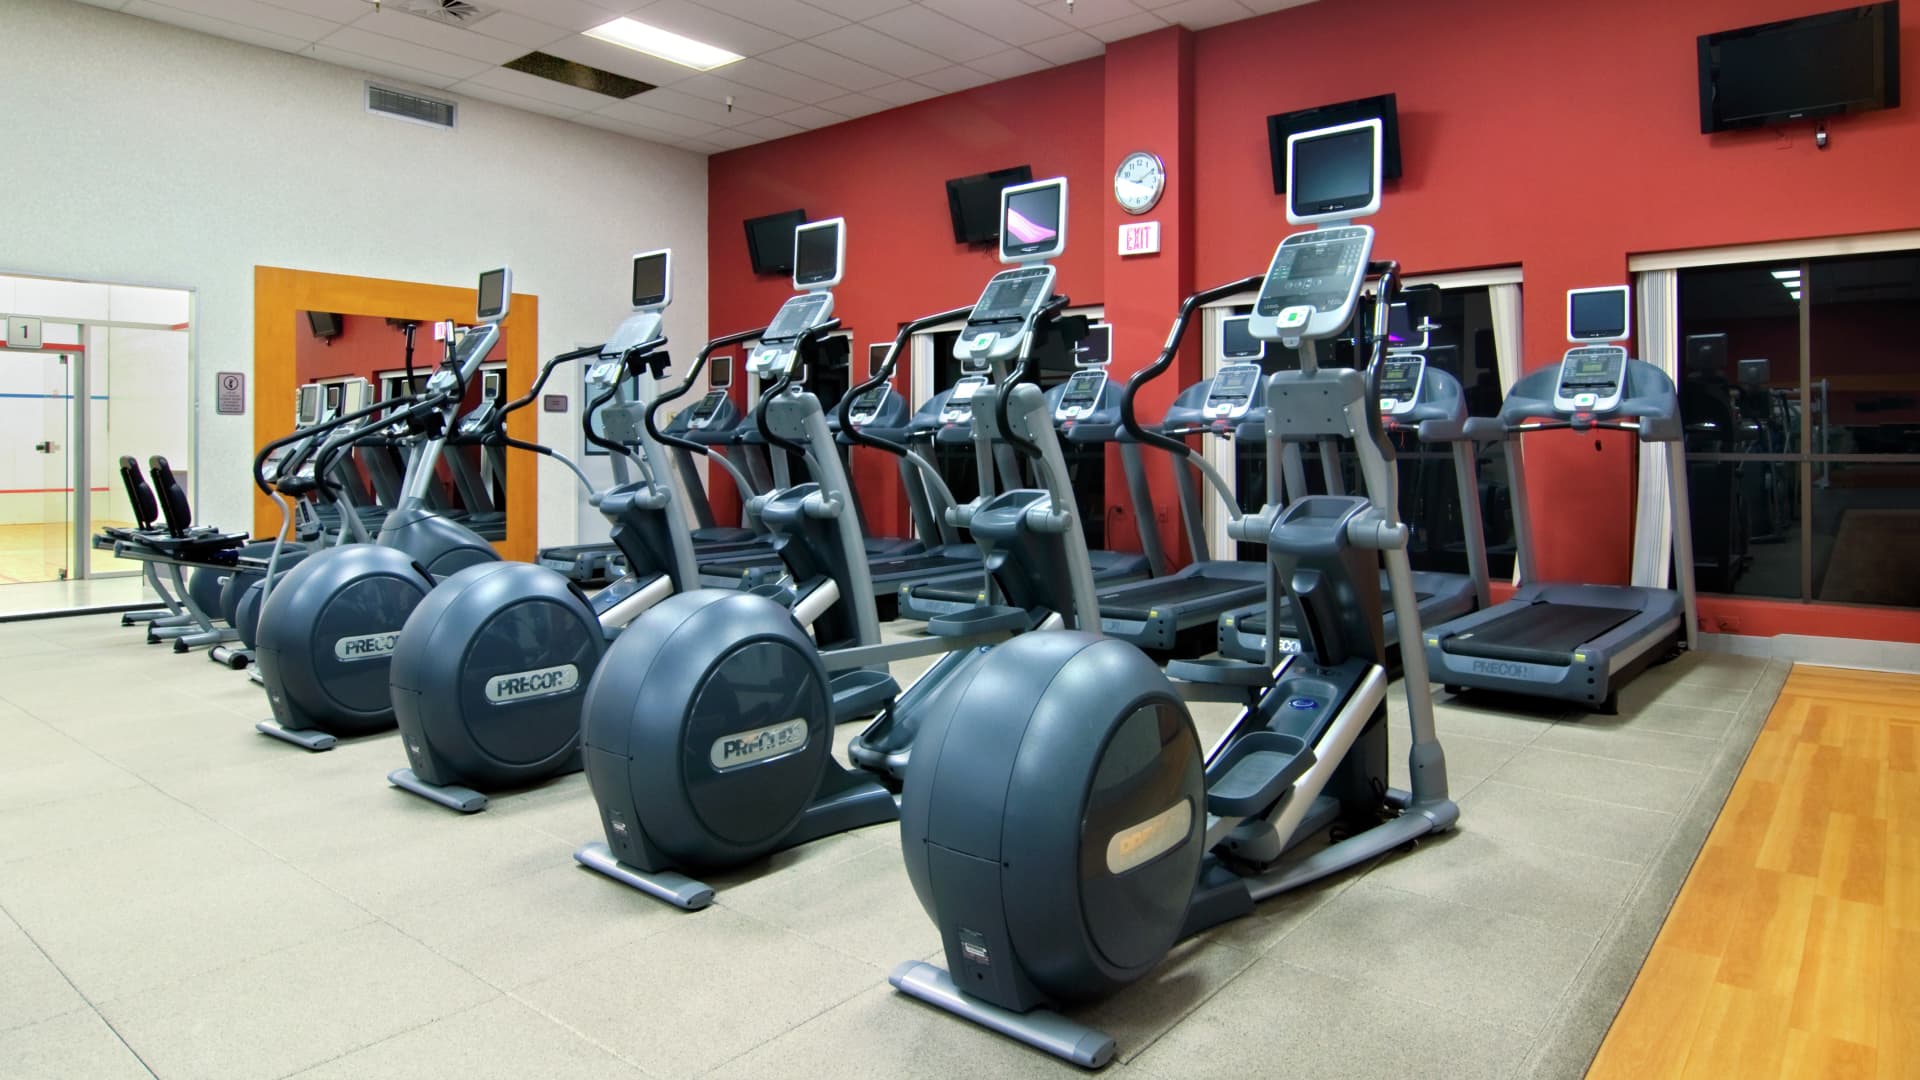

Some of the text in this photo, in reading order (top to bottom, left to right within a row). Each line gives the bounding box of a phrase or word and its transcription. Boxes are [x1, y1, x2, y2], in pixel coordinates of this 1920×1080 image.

[1126, 225, 1152, 251] EXIT
[20, 325, 28, 339] 1
[345, 635, 400, 655] PRECO
[497, 670, 563, 697] PRECOR
